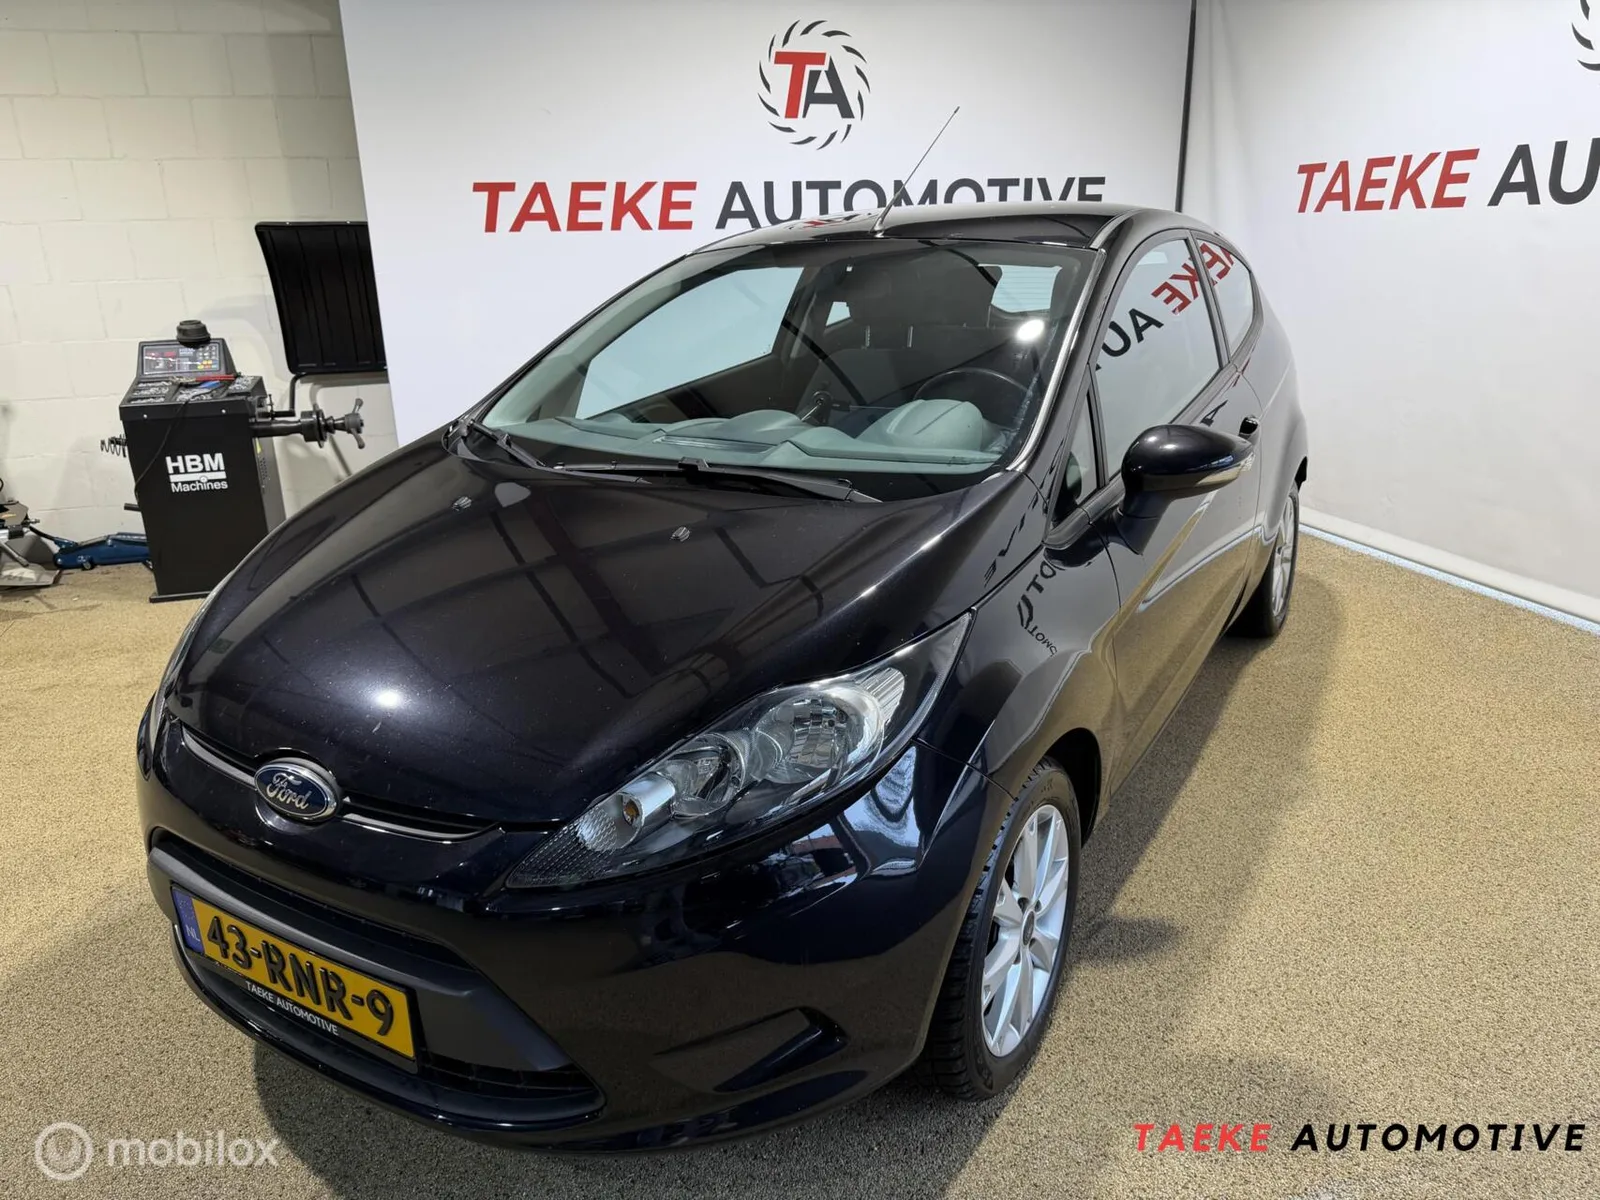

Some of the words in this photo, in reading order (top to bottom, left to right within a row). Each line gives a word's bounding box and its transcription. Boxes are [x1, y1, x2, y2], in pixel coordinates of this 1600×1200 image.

[772, 51, 855, 119] TA
[1297, 148, 1480, 213] TAEKE
[472, 181, 697, 233] TAEKE
[165, 452, 225, 474] HBM
[170, 480, 229, 493] Machines
[266, 772, 313, 810] Ford
[185, 924, 200, 942] NL
[206, 915, 395, 1037] 43-RNR-9
[245, 981, 275, 1004] TAEKE
[276, 996, 339, 1036] AUTOMOTIVE
